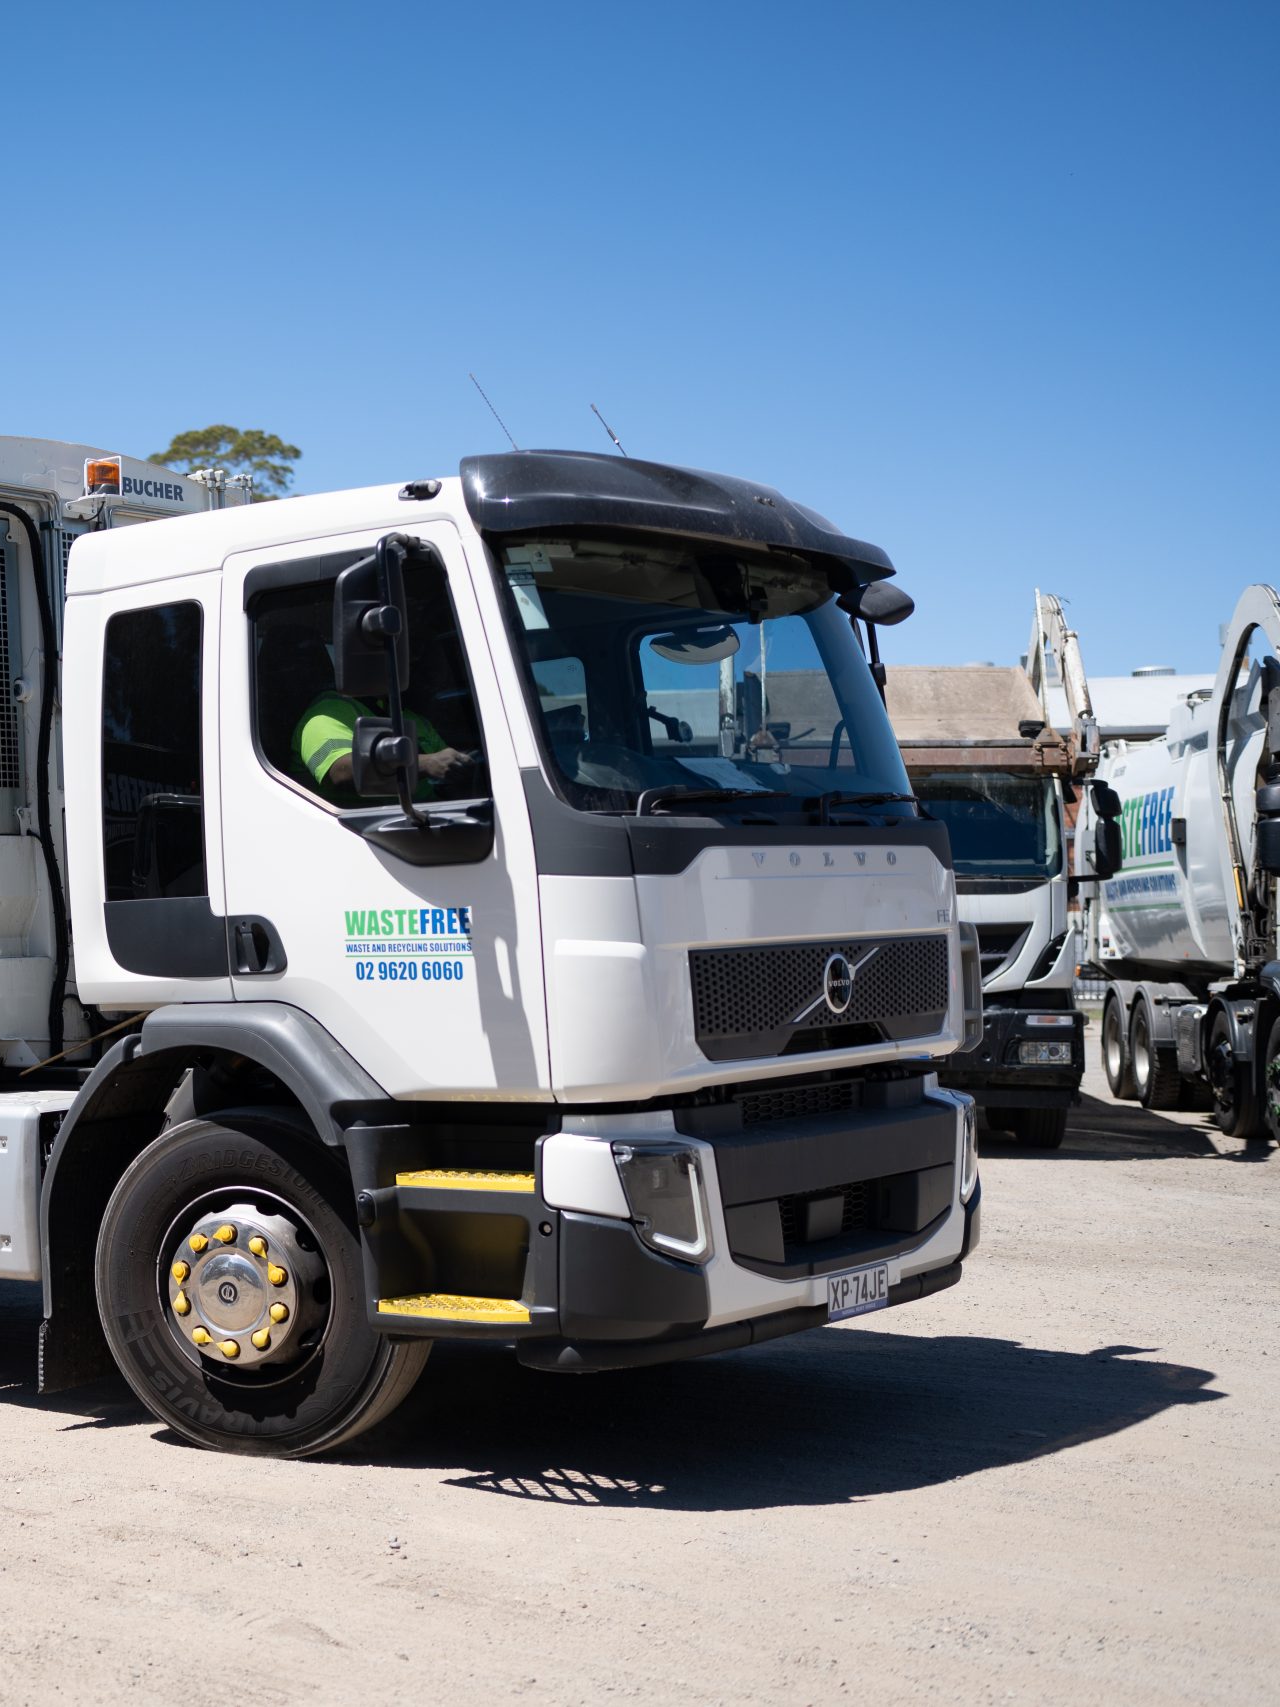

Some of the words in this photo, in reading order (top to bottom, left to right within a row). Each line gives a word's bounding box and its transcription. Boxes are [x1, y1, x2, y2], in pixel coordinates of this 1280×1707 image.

[122, 476, 184, 502] BUCHER
[1116, 786, 1175, 861] STEFREE
[752, 851, 897, 868] VOLVO
[344, 907, 471, 936] WASTEFREE
[346, 944, 370, 953] WASTE
[371, 943, 386, 953] AND
[388, 943, 428, 952] RECYCLING
[429, 942, 472, 951] SOLUTIONS
[356, 961, 374, 980] 02
[378, 961, 417, 980] 9620
[422, 961, 463, 980] 6060
[828, 979, 850, 988] VOLVO
